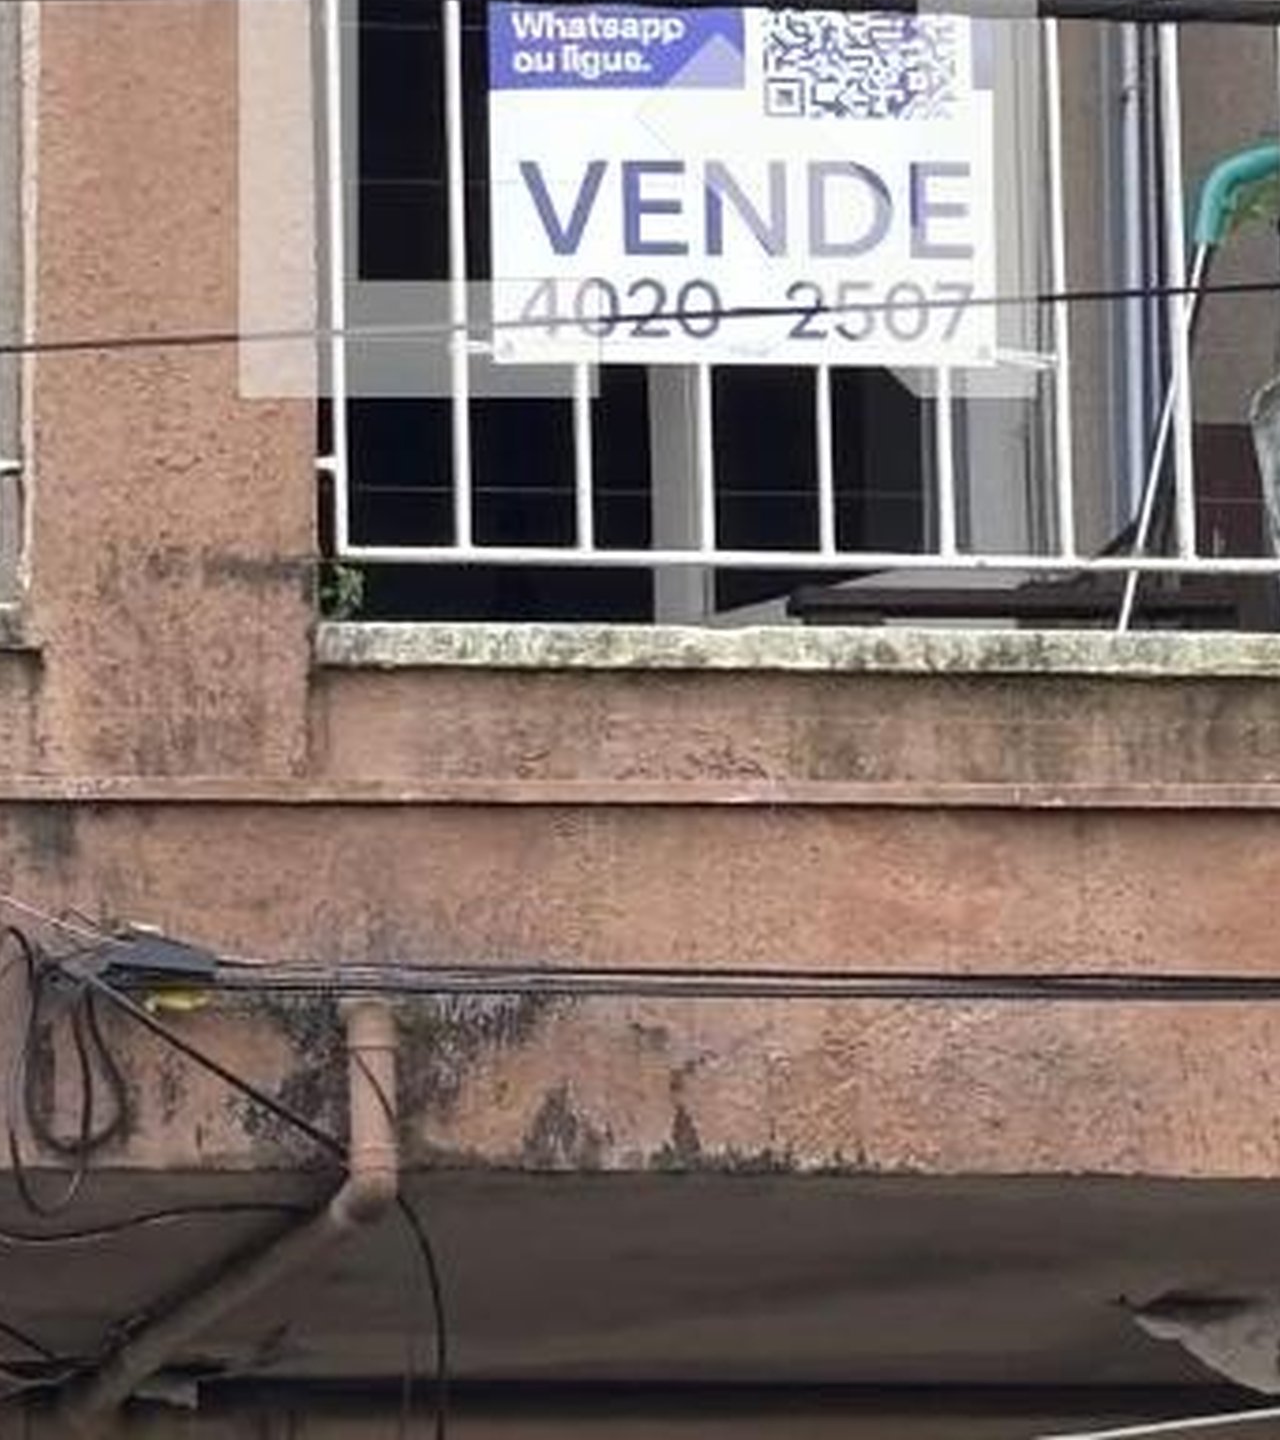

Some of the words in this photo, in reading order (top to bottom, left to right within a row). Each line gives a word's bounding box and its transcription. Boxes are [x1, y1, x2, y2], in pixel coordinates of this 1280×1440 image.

[511, 11, 685, 47] Whatsapp
[513, 50, 555, 73] ou
[519, 159, 976, 260] VENDE
[519, 276, 723, 339] 4020
